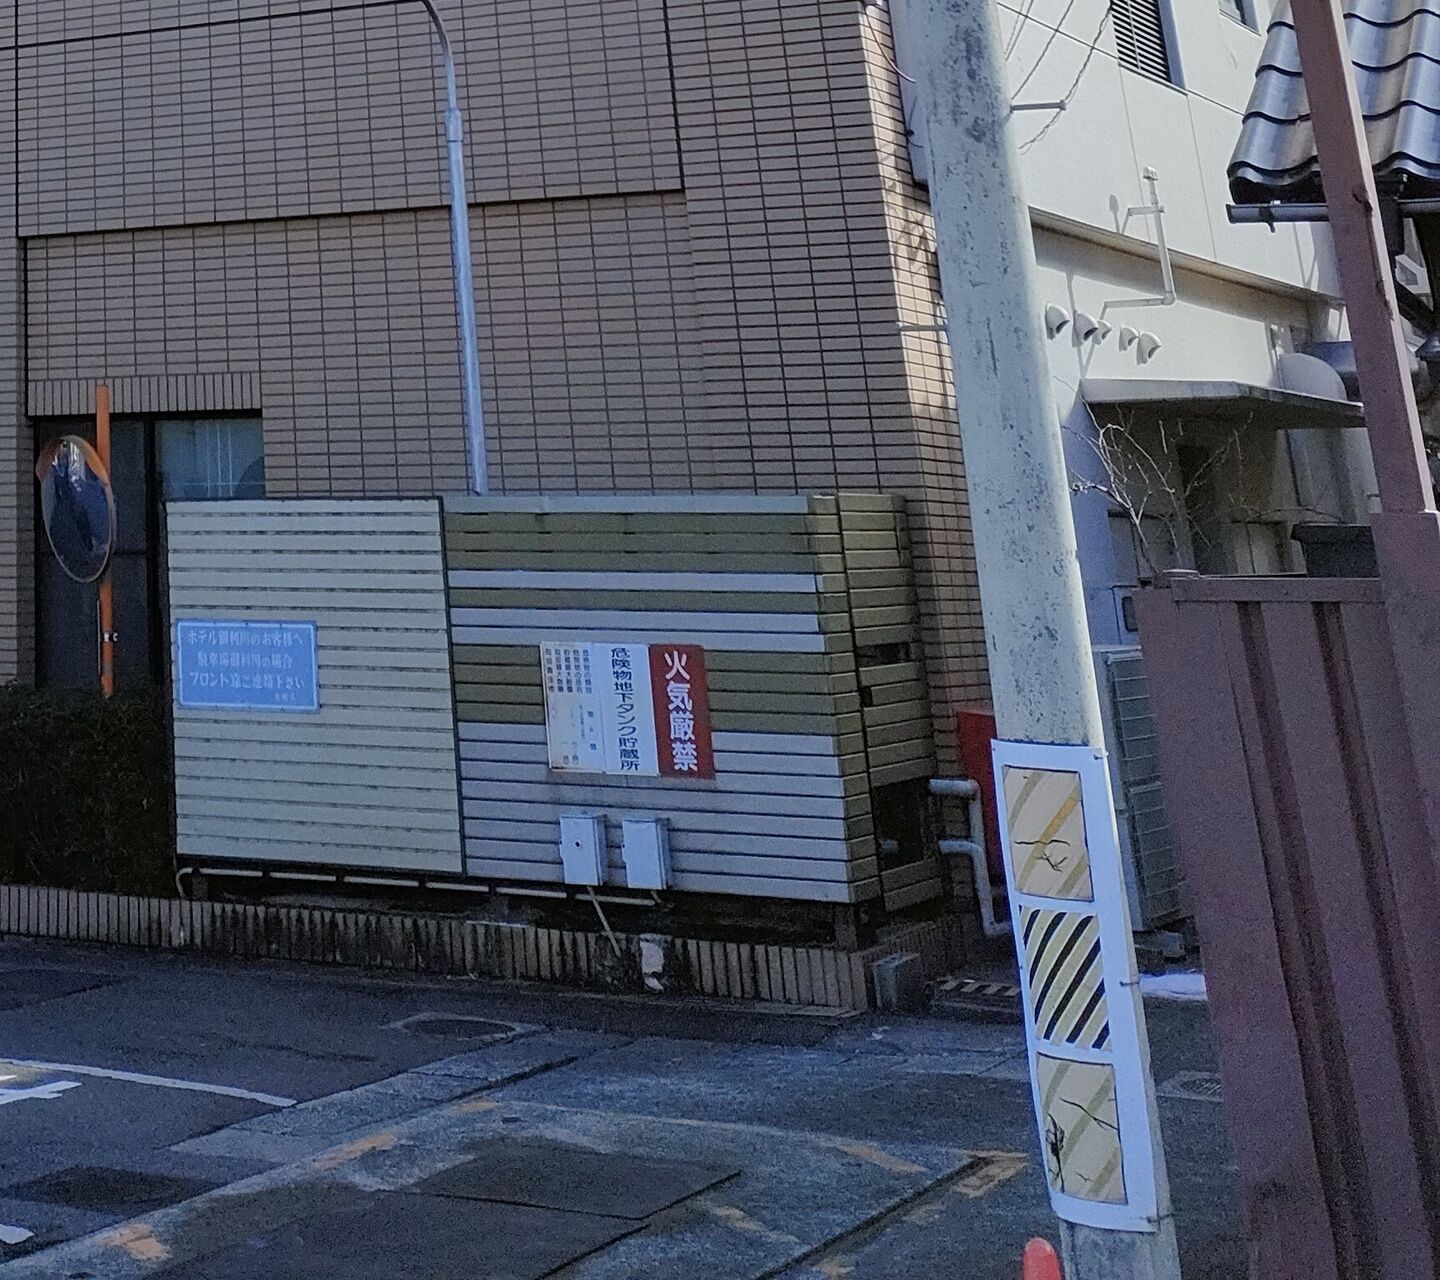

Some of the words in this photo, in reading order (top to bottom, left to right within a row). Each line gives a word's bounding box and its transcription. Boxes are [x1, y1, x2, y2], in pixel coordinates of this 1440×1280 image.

[611, 647, 640, 771] 危険物地下タンク貯蔵所
[664, 650, 698, 772] 火気厳禁
